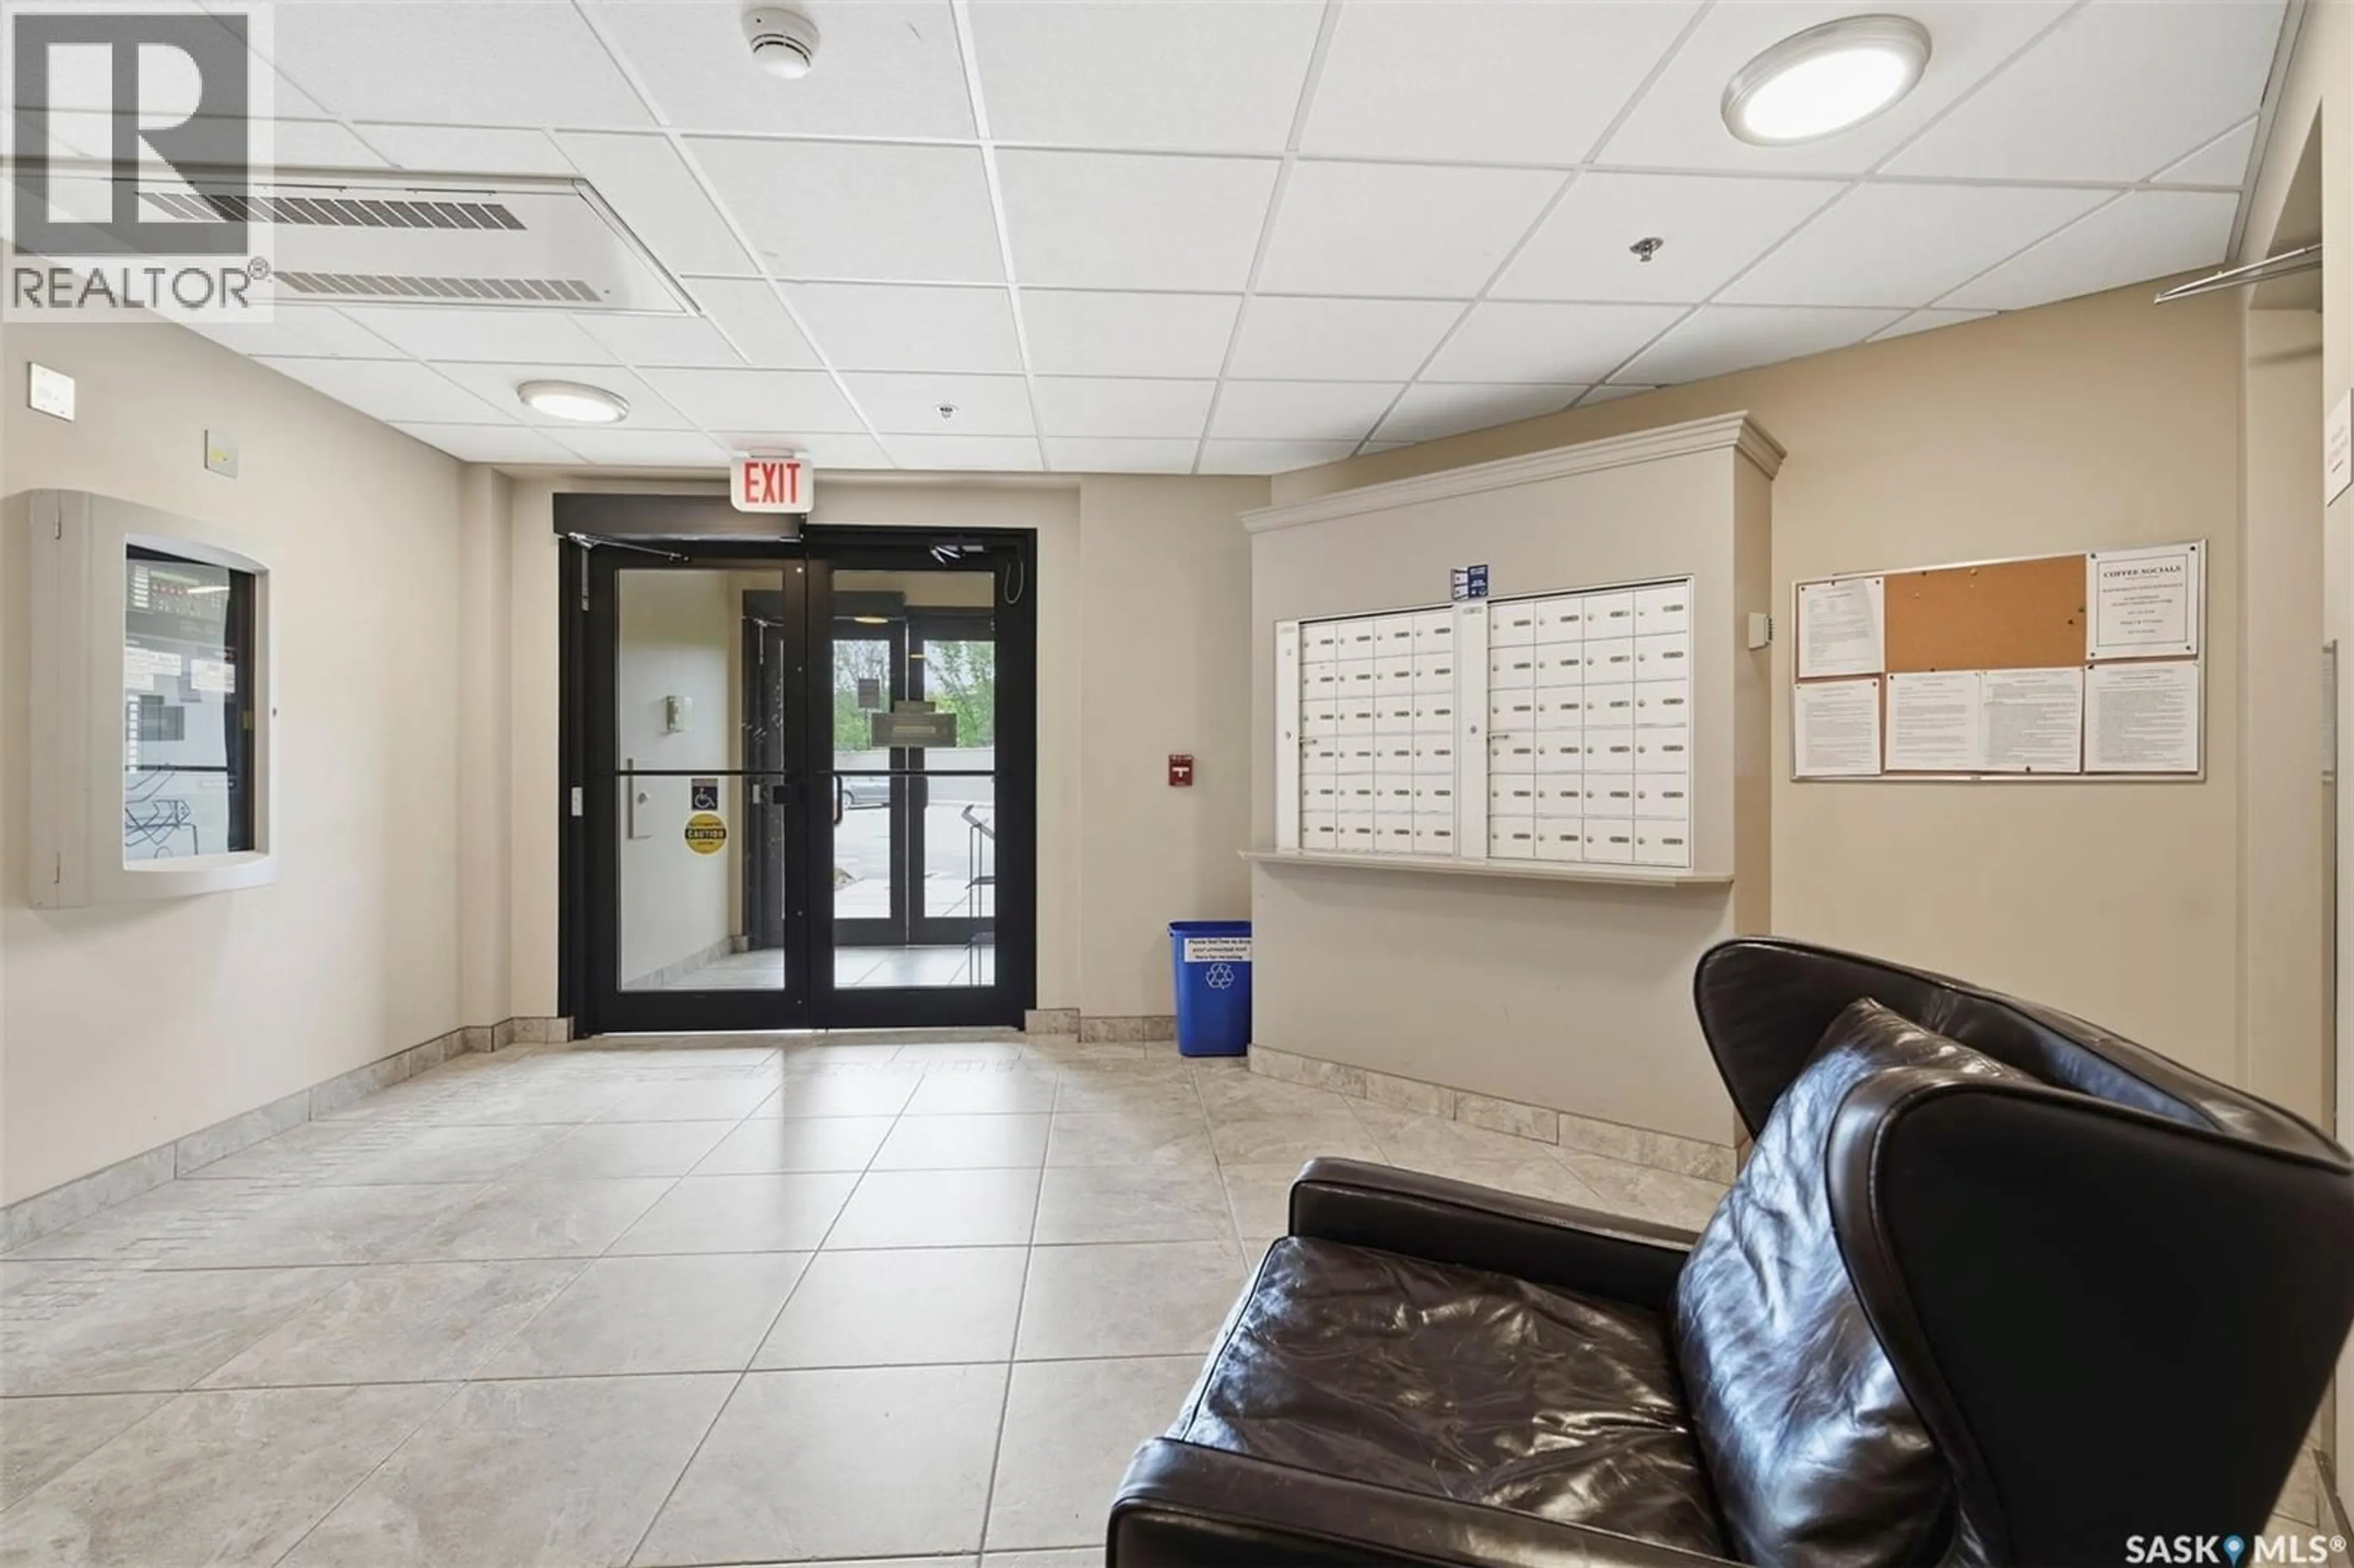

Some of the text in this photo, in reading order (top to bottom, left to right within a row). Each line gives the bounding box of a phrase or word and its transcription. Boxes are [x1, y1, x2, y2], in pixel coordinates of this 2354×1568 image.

[744, 462, 801, 504] EXIT
[2103, 569, 2138, 578] COFFEE
[2141, 565, 2181, 575] SOCIALS
